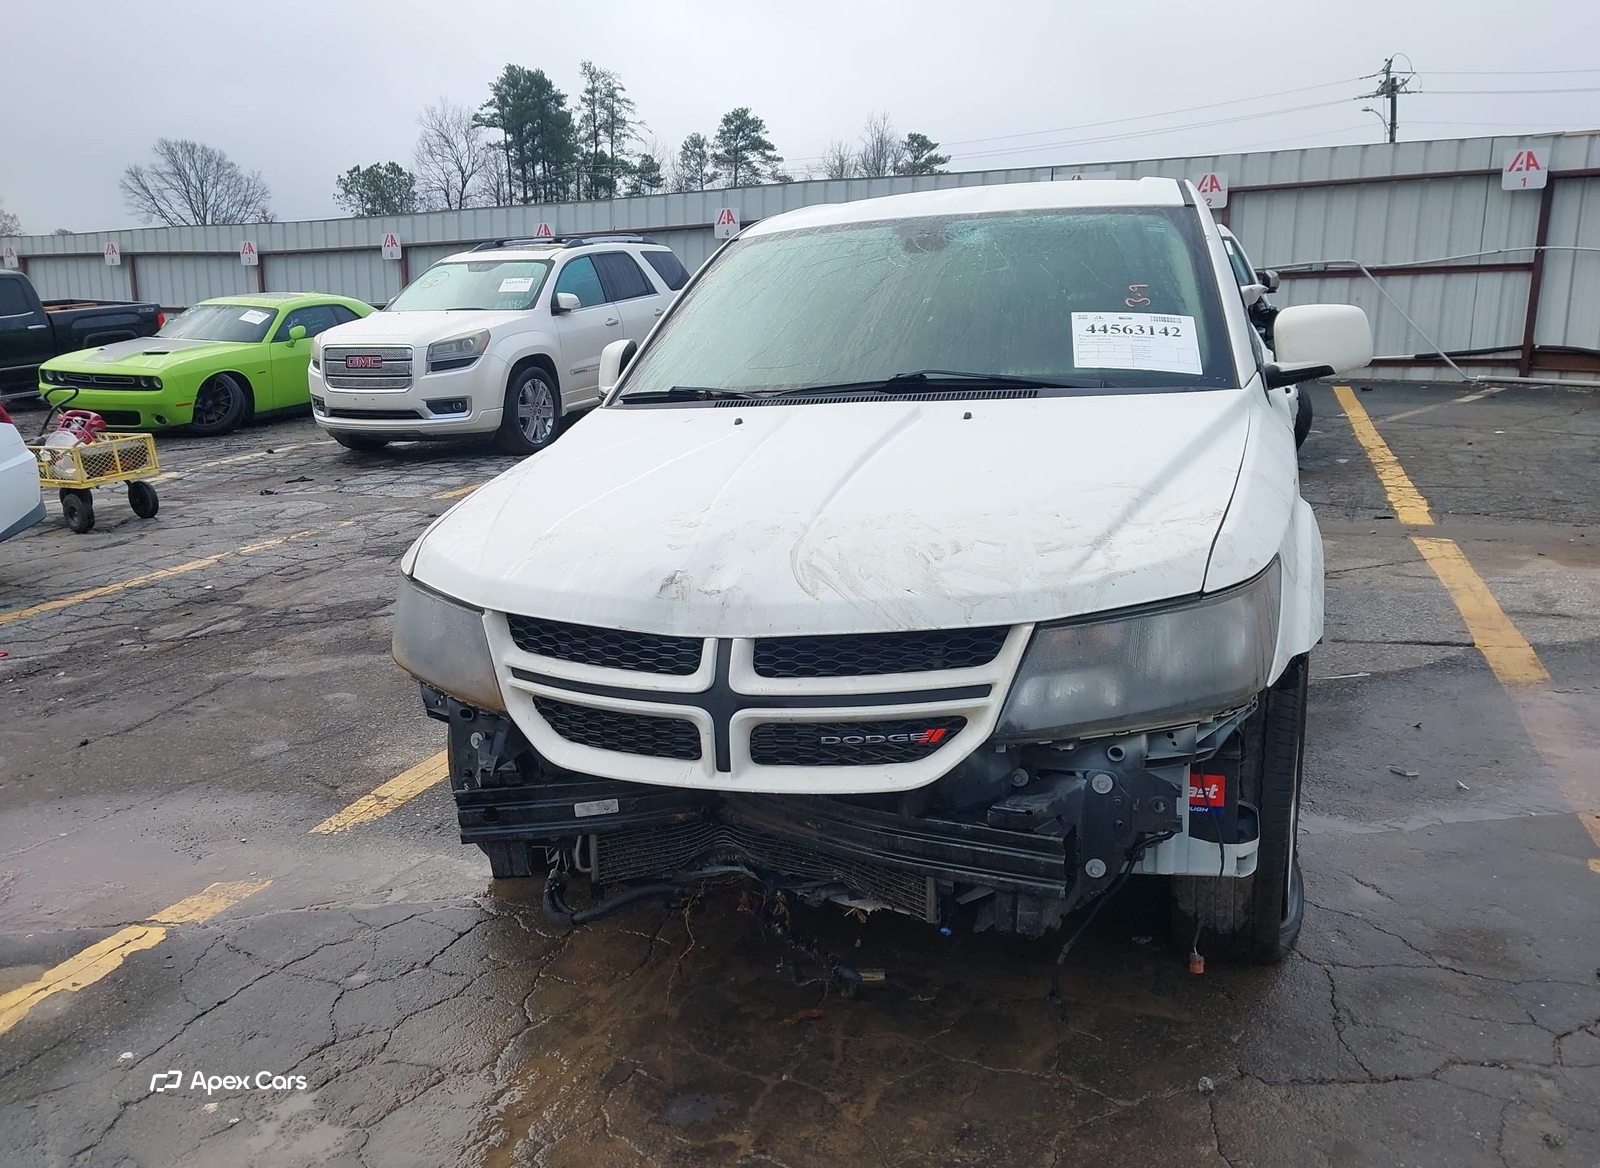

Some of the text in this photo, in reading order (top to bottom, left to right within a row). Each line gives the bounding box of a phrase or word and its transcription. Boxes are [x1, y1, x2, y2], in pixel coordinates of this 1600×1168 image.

[1521, 177, 1527, 187] 1
[1206, 197, 1212, 207] 2
[1085, 323, 1182, 338] 44563142
[347, 356, 382, 368] GMC
[820, 732, 930, 745] DODGE
